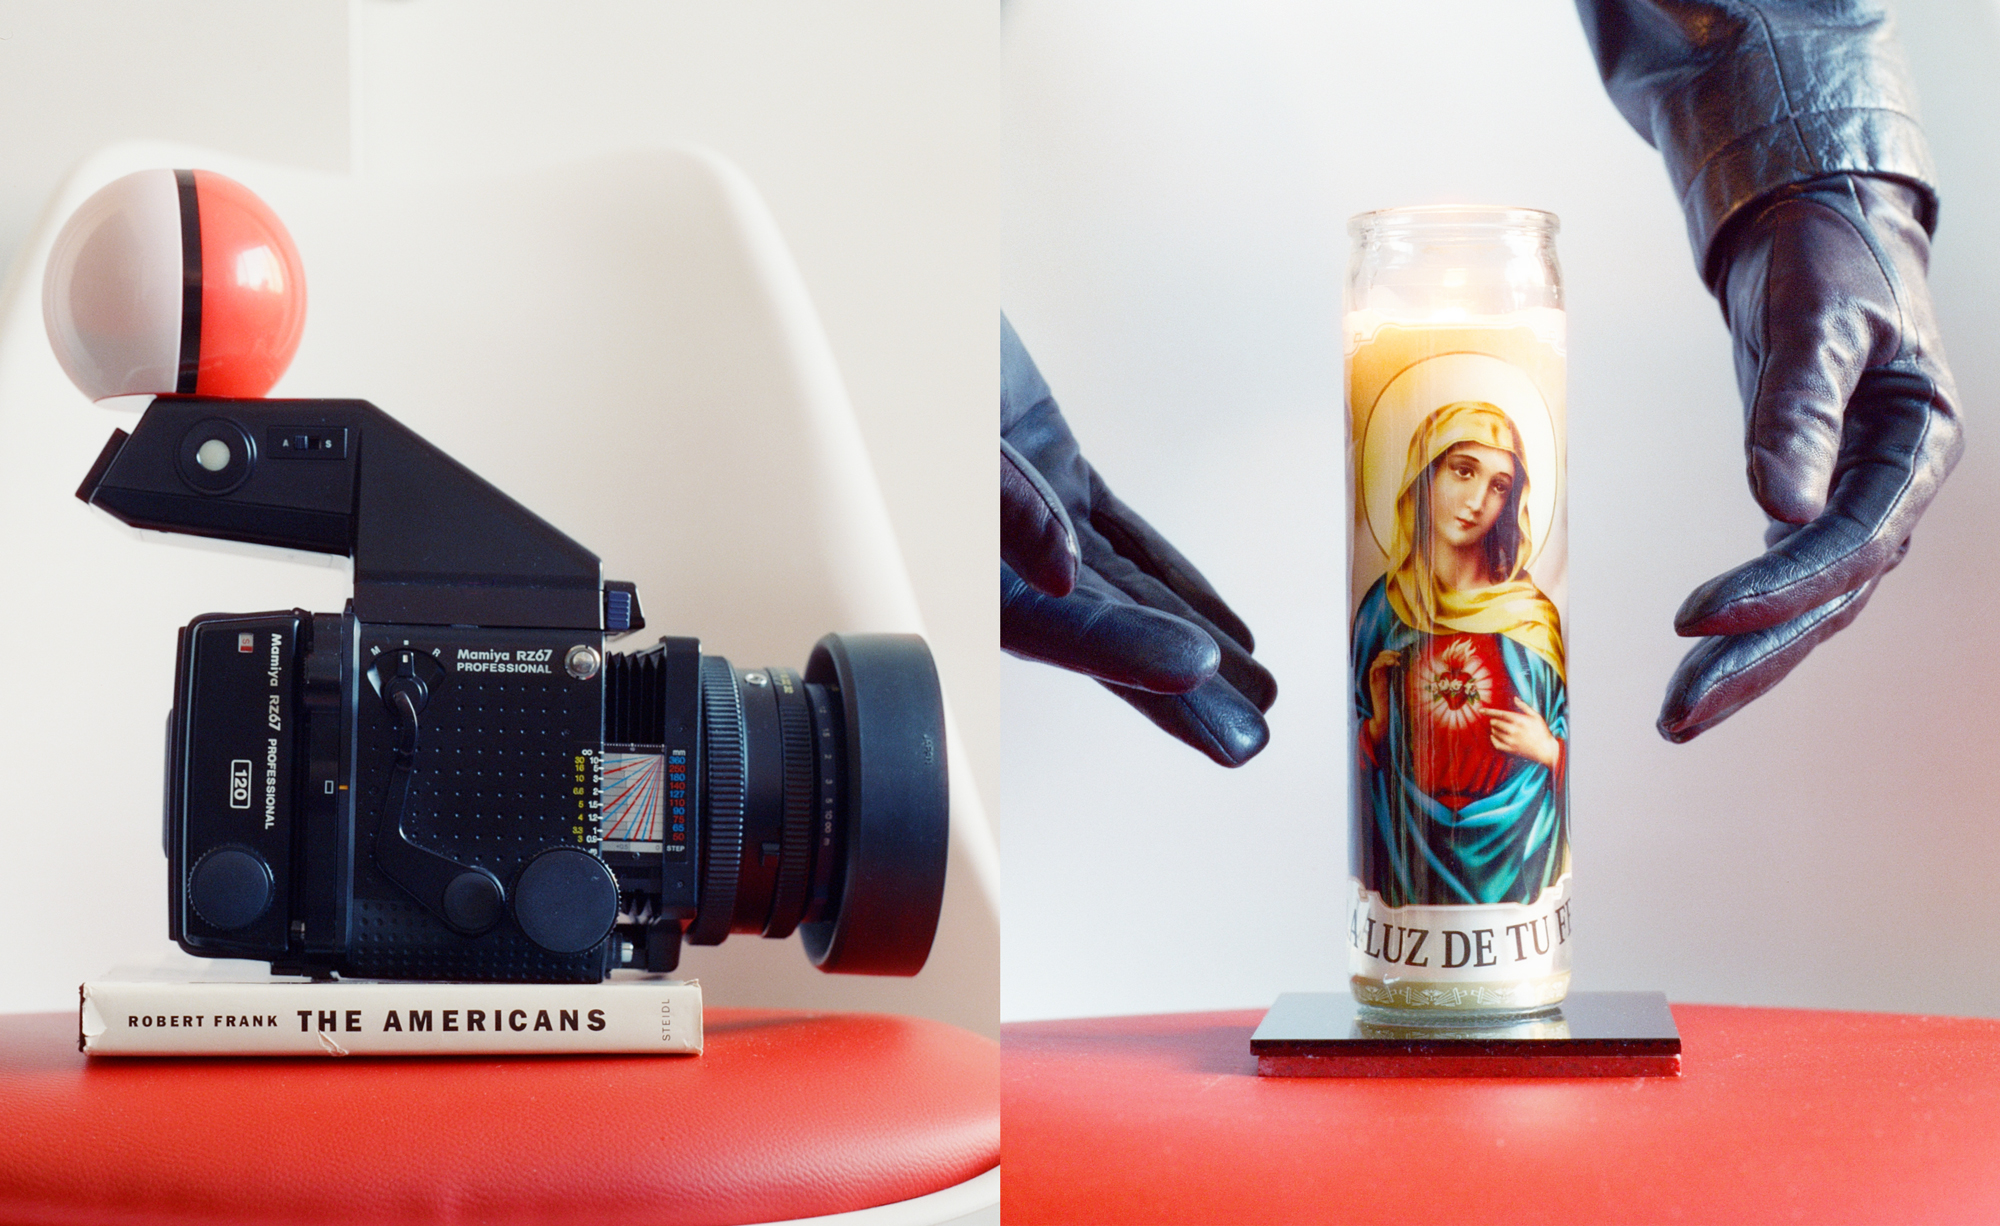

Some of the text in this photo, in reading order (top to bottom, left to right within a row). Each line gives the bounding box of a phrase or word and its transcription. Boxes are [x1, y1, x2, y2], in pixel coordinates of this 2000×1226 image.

[282, 439, 289, 448] A
[325, 440, 332, 448] S
[370, 646, 381, 656] M
[432, 647, 441, 658] R
[457, 649, 552, 662] Mamiya RZ67
[456, 662, 552, 674] PROFESSIONAL
[265, 633, 282, 830] Mamiya RZ67 PROFESSIONAL
[590, 756, 599, 764] 10
[669, 756, 686, 764] 360
[669, 765, 686, 773] 250
[575, 774, 584, 782] 10
[670, 774, 686, 782] 180
[234, 770, 248, 800] 120
[670, 782, 686, 790] 140
[592, 788, 598, 796] 2
[670, 790, 685, 798] 127
[673, 807, 685, 815] 90
[824, 810, 832, 820] 10
[674, 816, 685, 824] 75
[672, 824, 684, 832] 65
[673, 832, 684, 840] 50
[1364, 917, 1429, 968] LUZ
[1441, 929, 1497, 968] DE
[1506, 916, 1550, 962] TU
[128, 1009, 606, 1032] ROBERT FRANK THE AMERICANS
[662, 998, 670, 1042] STEIDL
